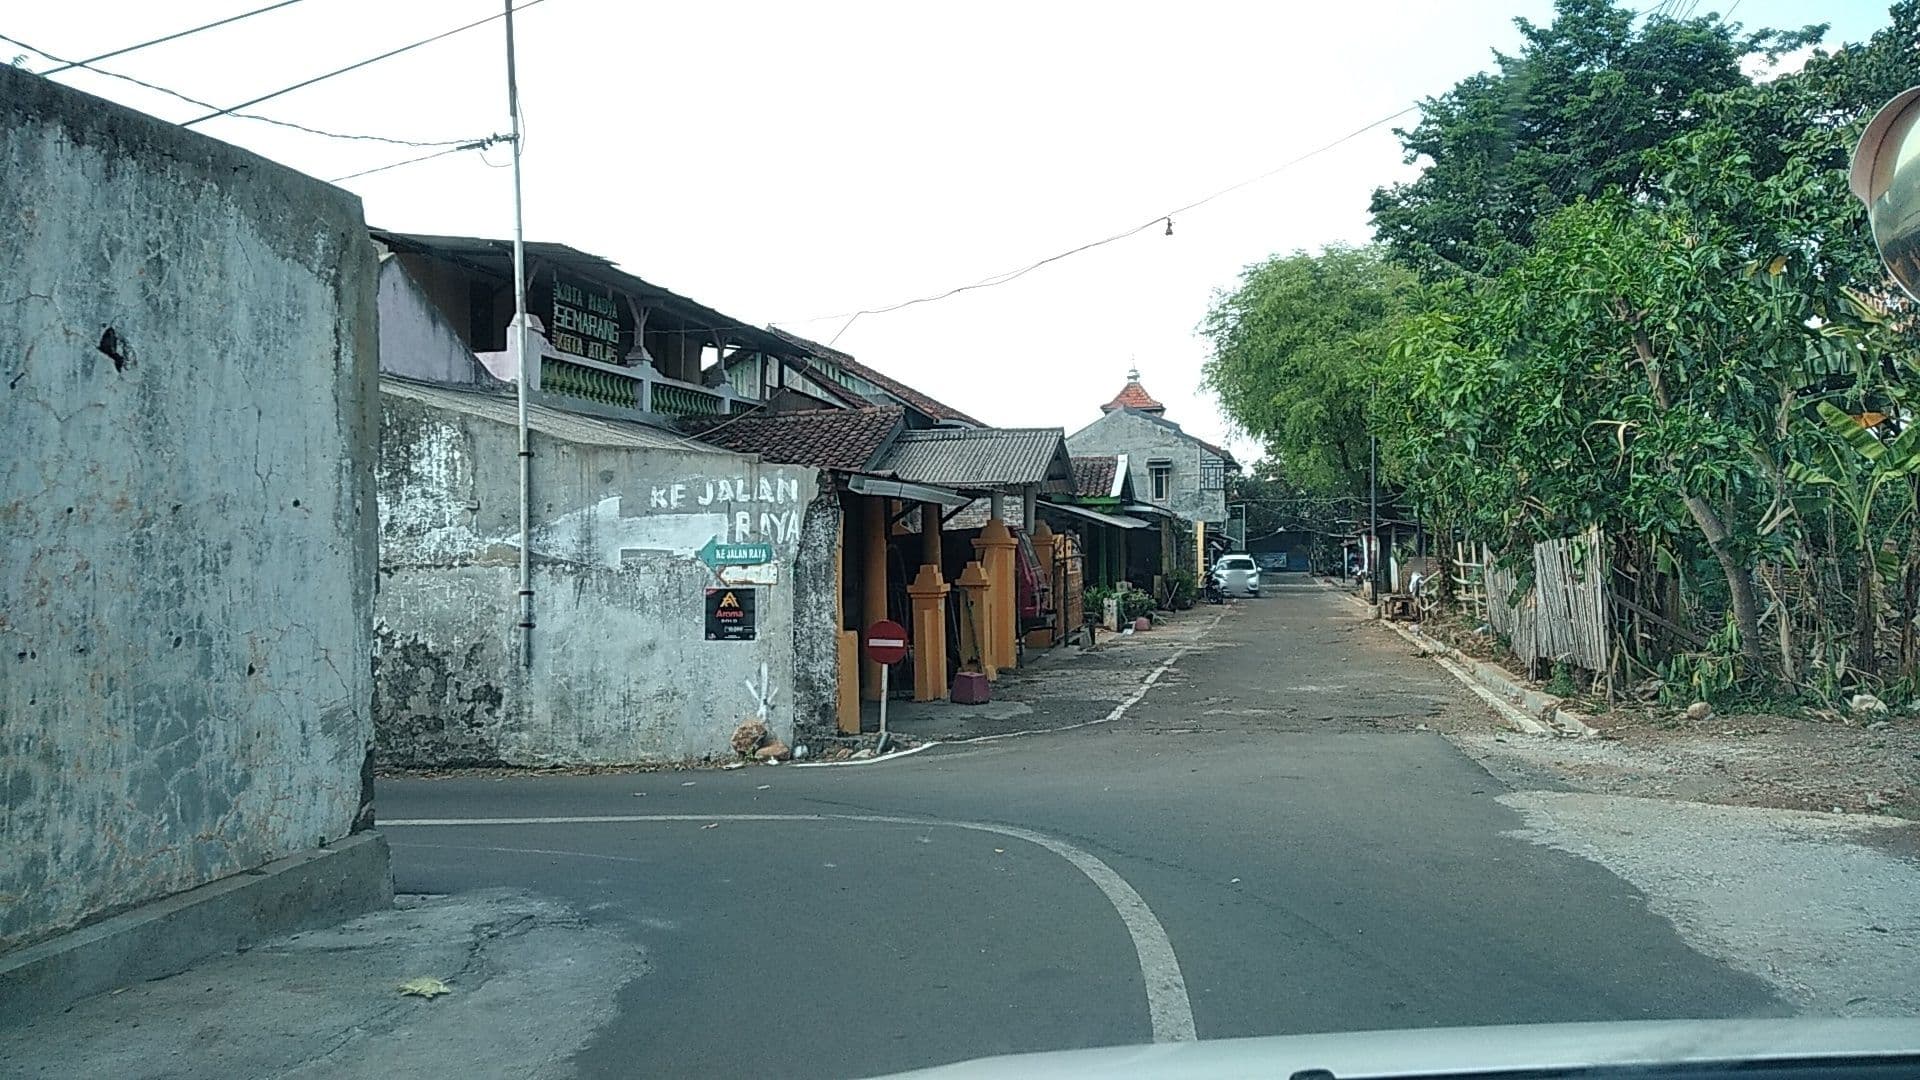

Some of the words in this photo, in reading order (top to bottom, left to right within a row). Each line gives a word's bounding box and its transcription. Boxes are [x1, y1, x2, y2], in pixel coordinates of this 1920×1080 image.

[556, 282, 583, 307] KOTA
[554, 303, 620, 344] SEMARANG
[651, 483, 687, 510] KE
[698, 476, 798, 505] JALAN
[735, 510, 800, 545] RAYA
[715, 548, 725, 559] KE
[726, 548, 748, 559] JALAN
[748, 548, 767, 562] RAYA
[715, 609, 744, 618] Aroma
